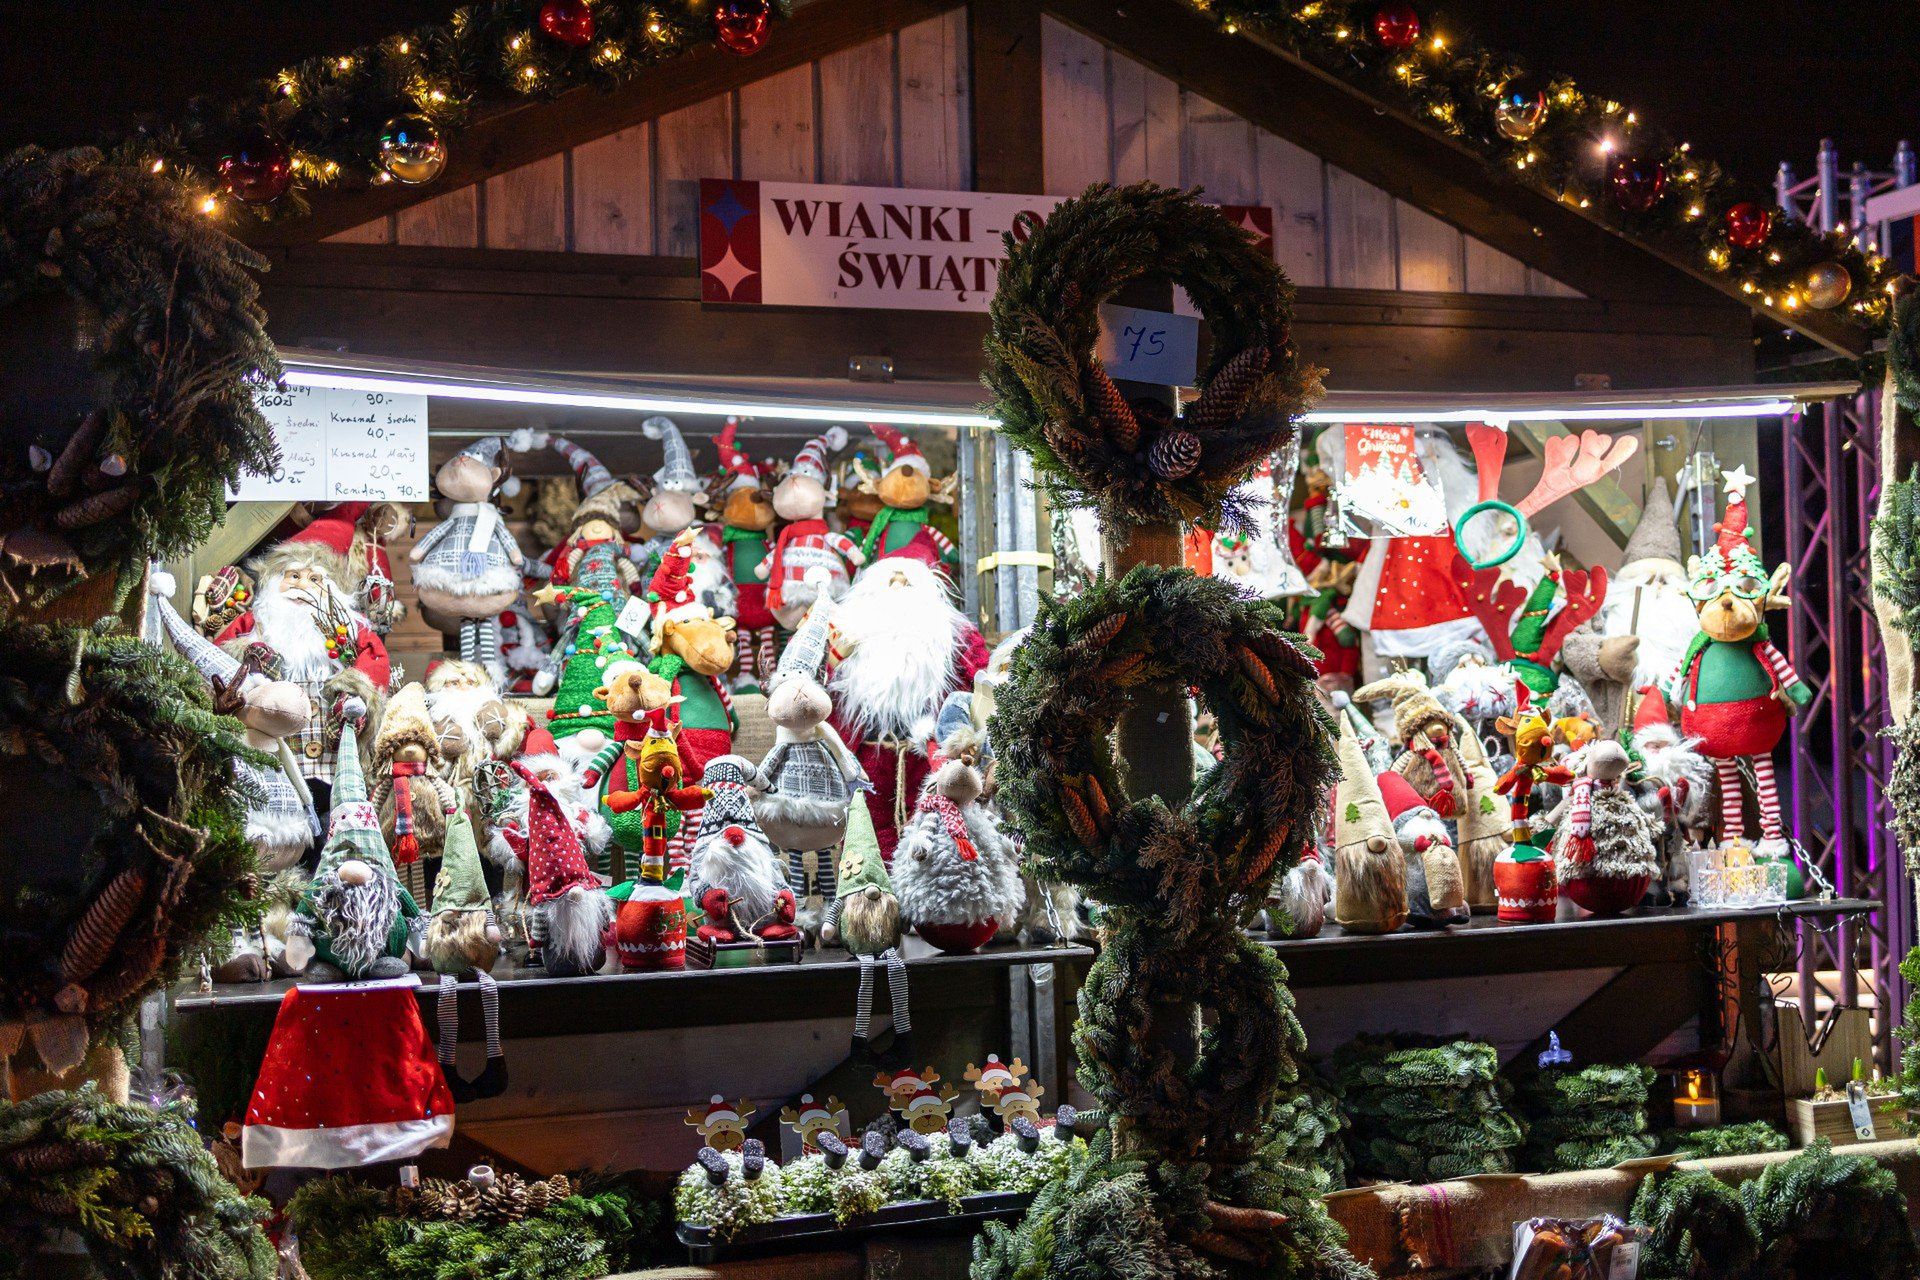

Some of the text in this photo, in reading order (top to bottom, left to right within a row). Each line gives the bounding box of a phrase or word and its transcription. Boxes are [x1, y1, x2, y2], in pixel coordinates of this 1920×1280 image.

[771, 198, 974, 243] WIANKI
[837, 243, 1010, 302] ŚWIĄT
[1124, 325, 1166, 362] 75
